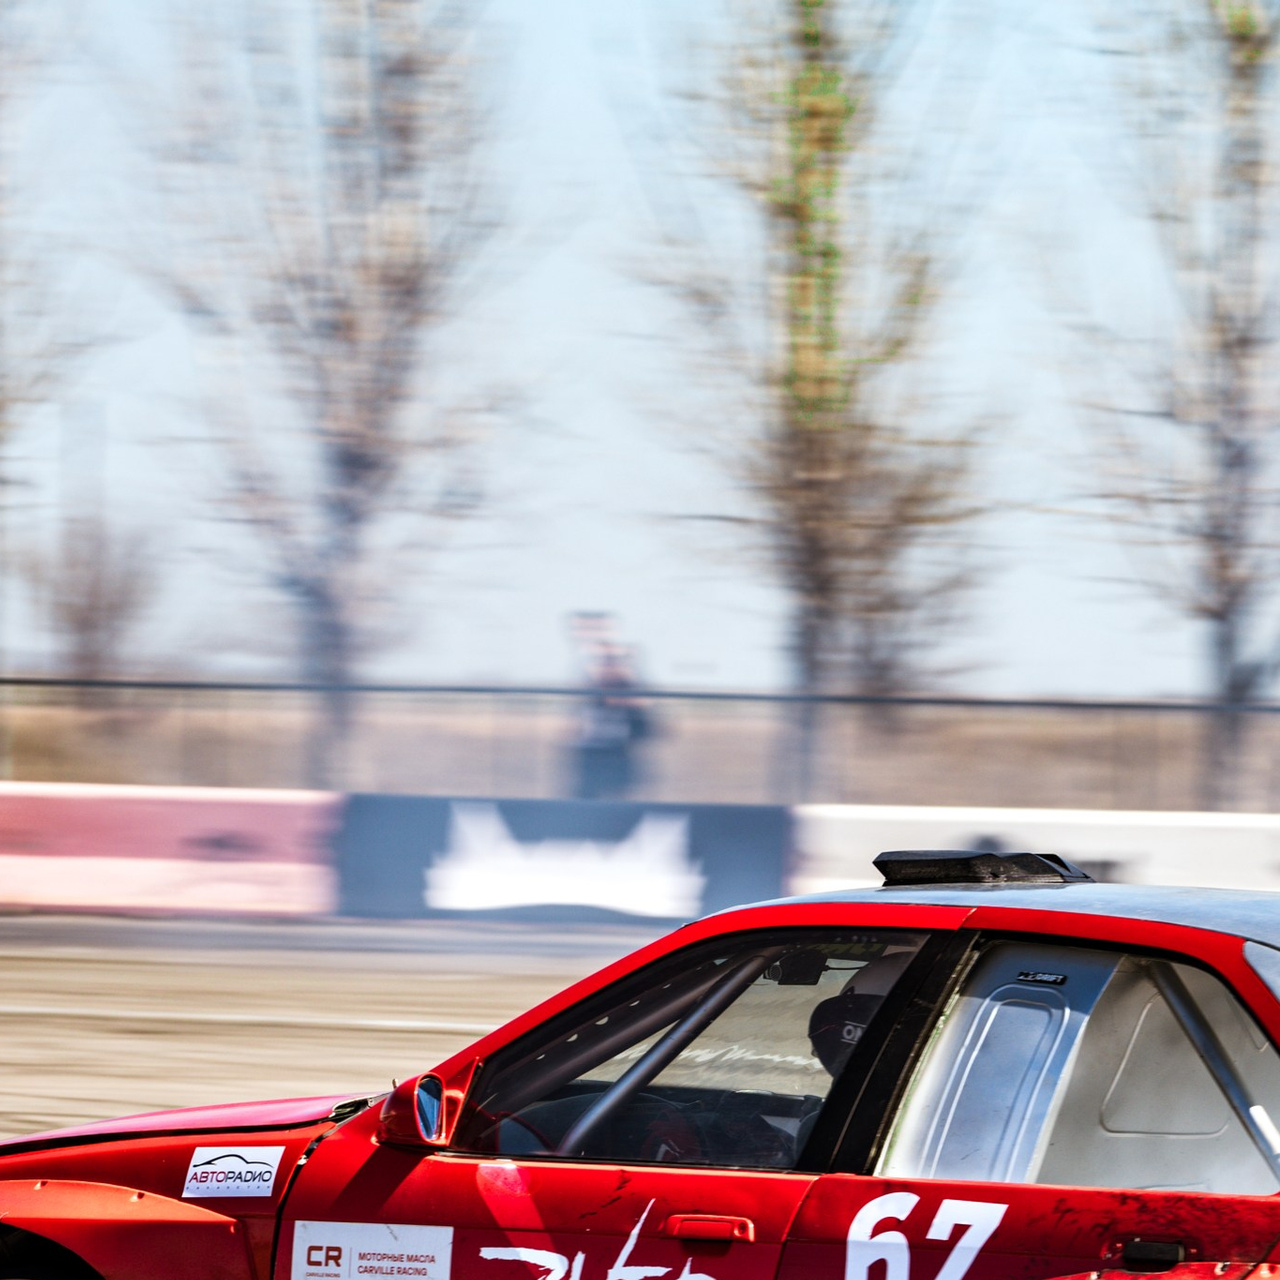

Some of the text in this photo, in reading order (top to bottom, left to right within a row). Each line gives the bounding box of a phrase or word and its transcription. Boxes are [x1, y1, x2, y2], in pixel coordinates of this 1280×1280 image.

[306, 1245, 343, 1267] CR
[358, 1252, 436, 1264] МОТОРНЫЕ МАСЛА
[357, 1265, 428, 1277] CARVILLE RACING
